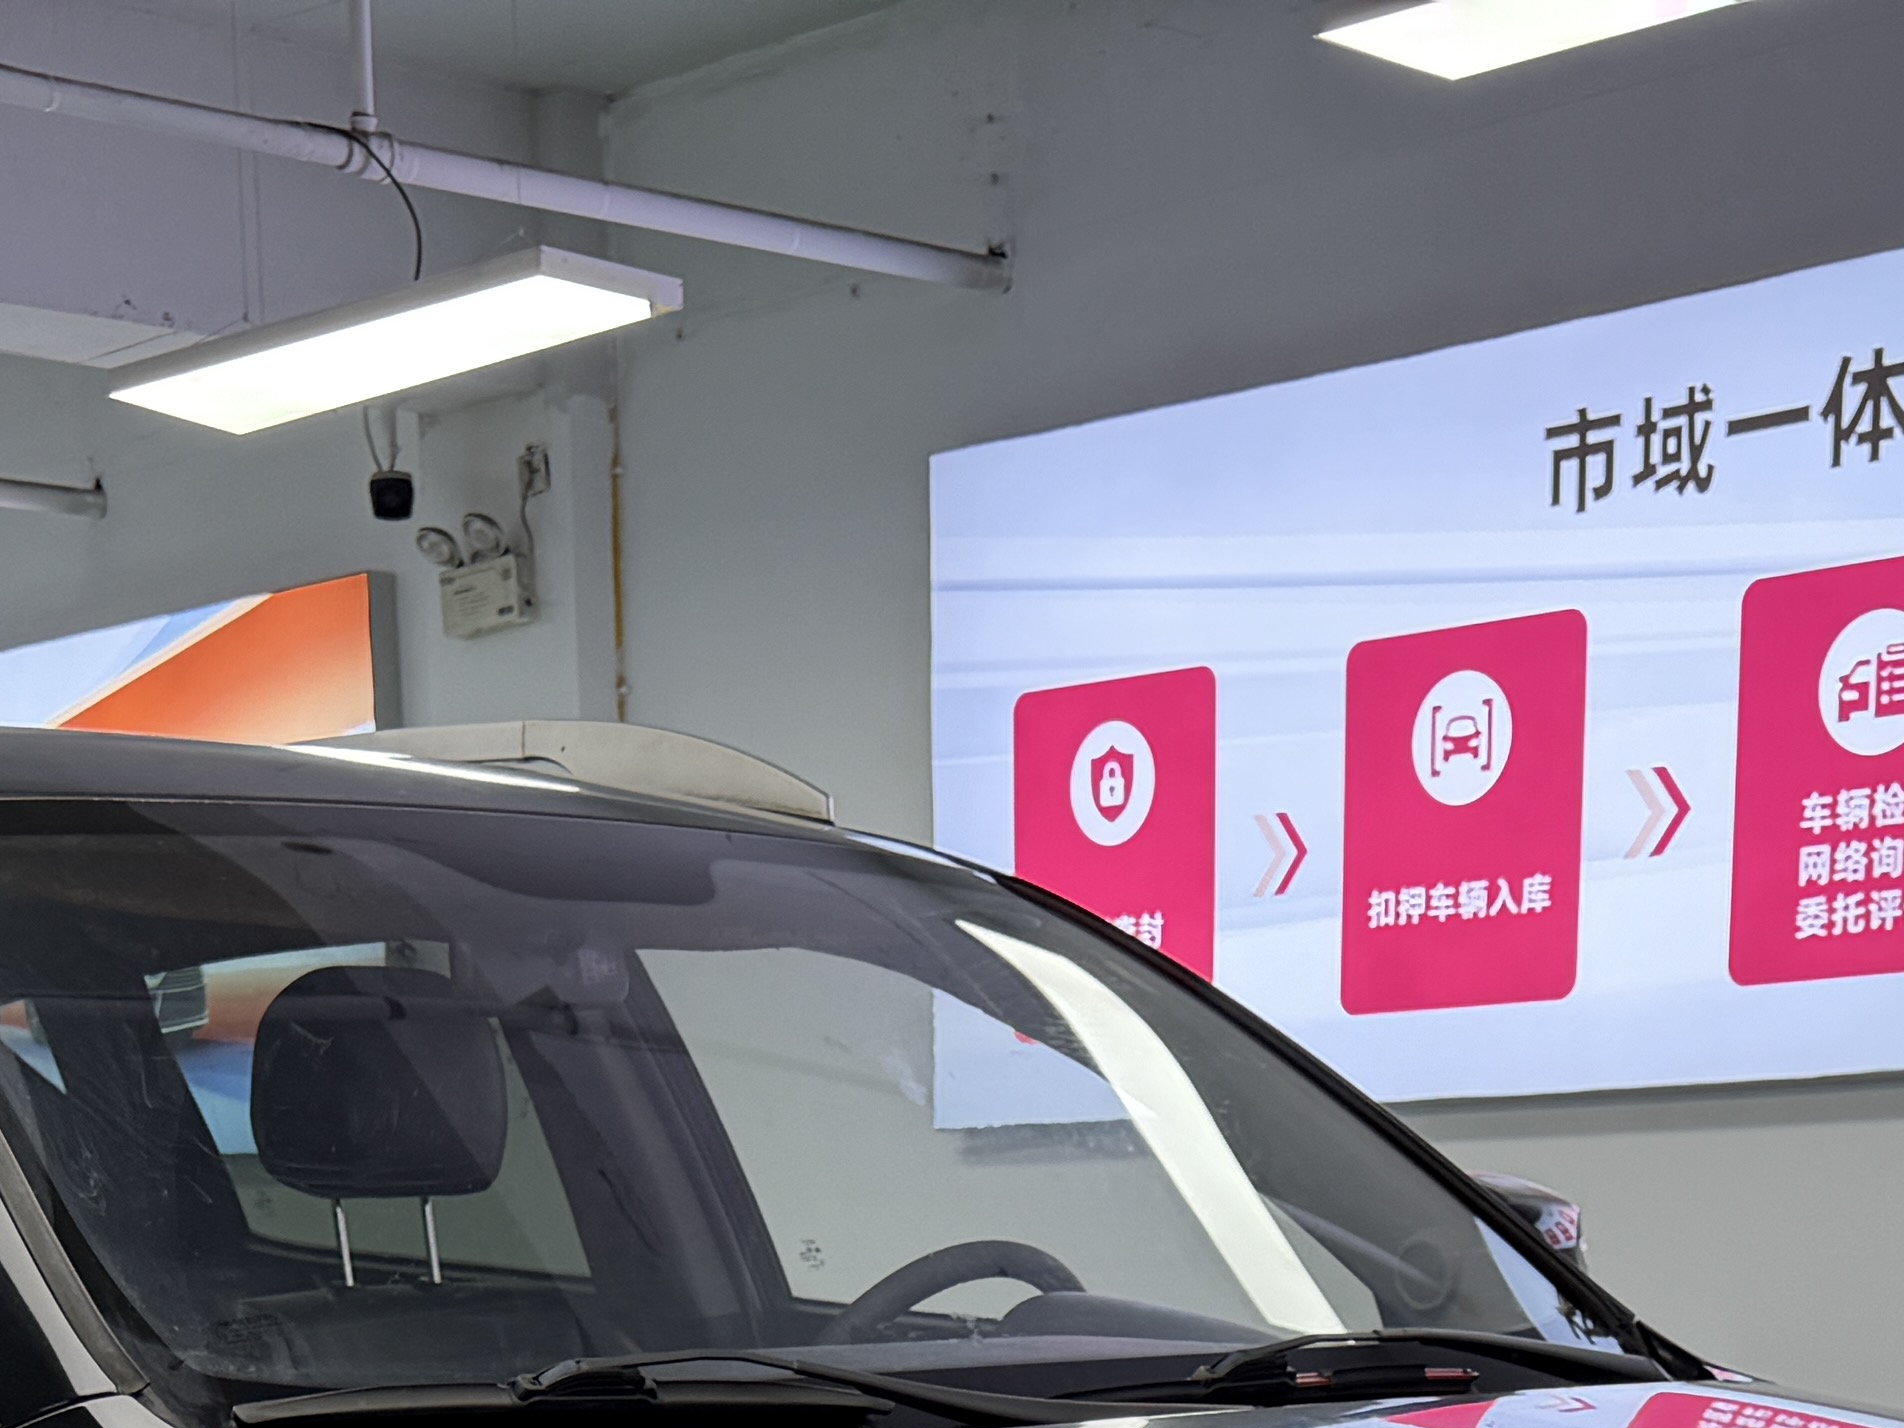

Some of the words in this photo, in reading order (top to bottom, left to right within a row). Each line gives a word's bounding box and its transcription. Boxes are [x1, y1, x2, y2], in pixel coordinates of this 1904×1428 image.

[1367, 872, 1552, 928] 扣押车辆入库
